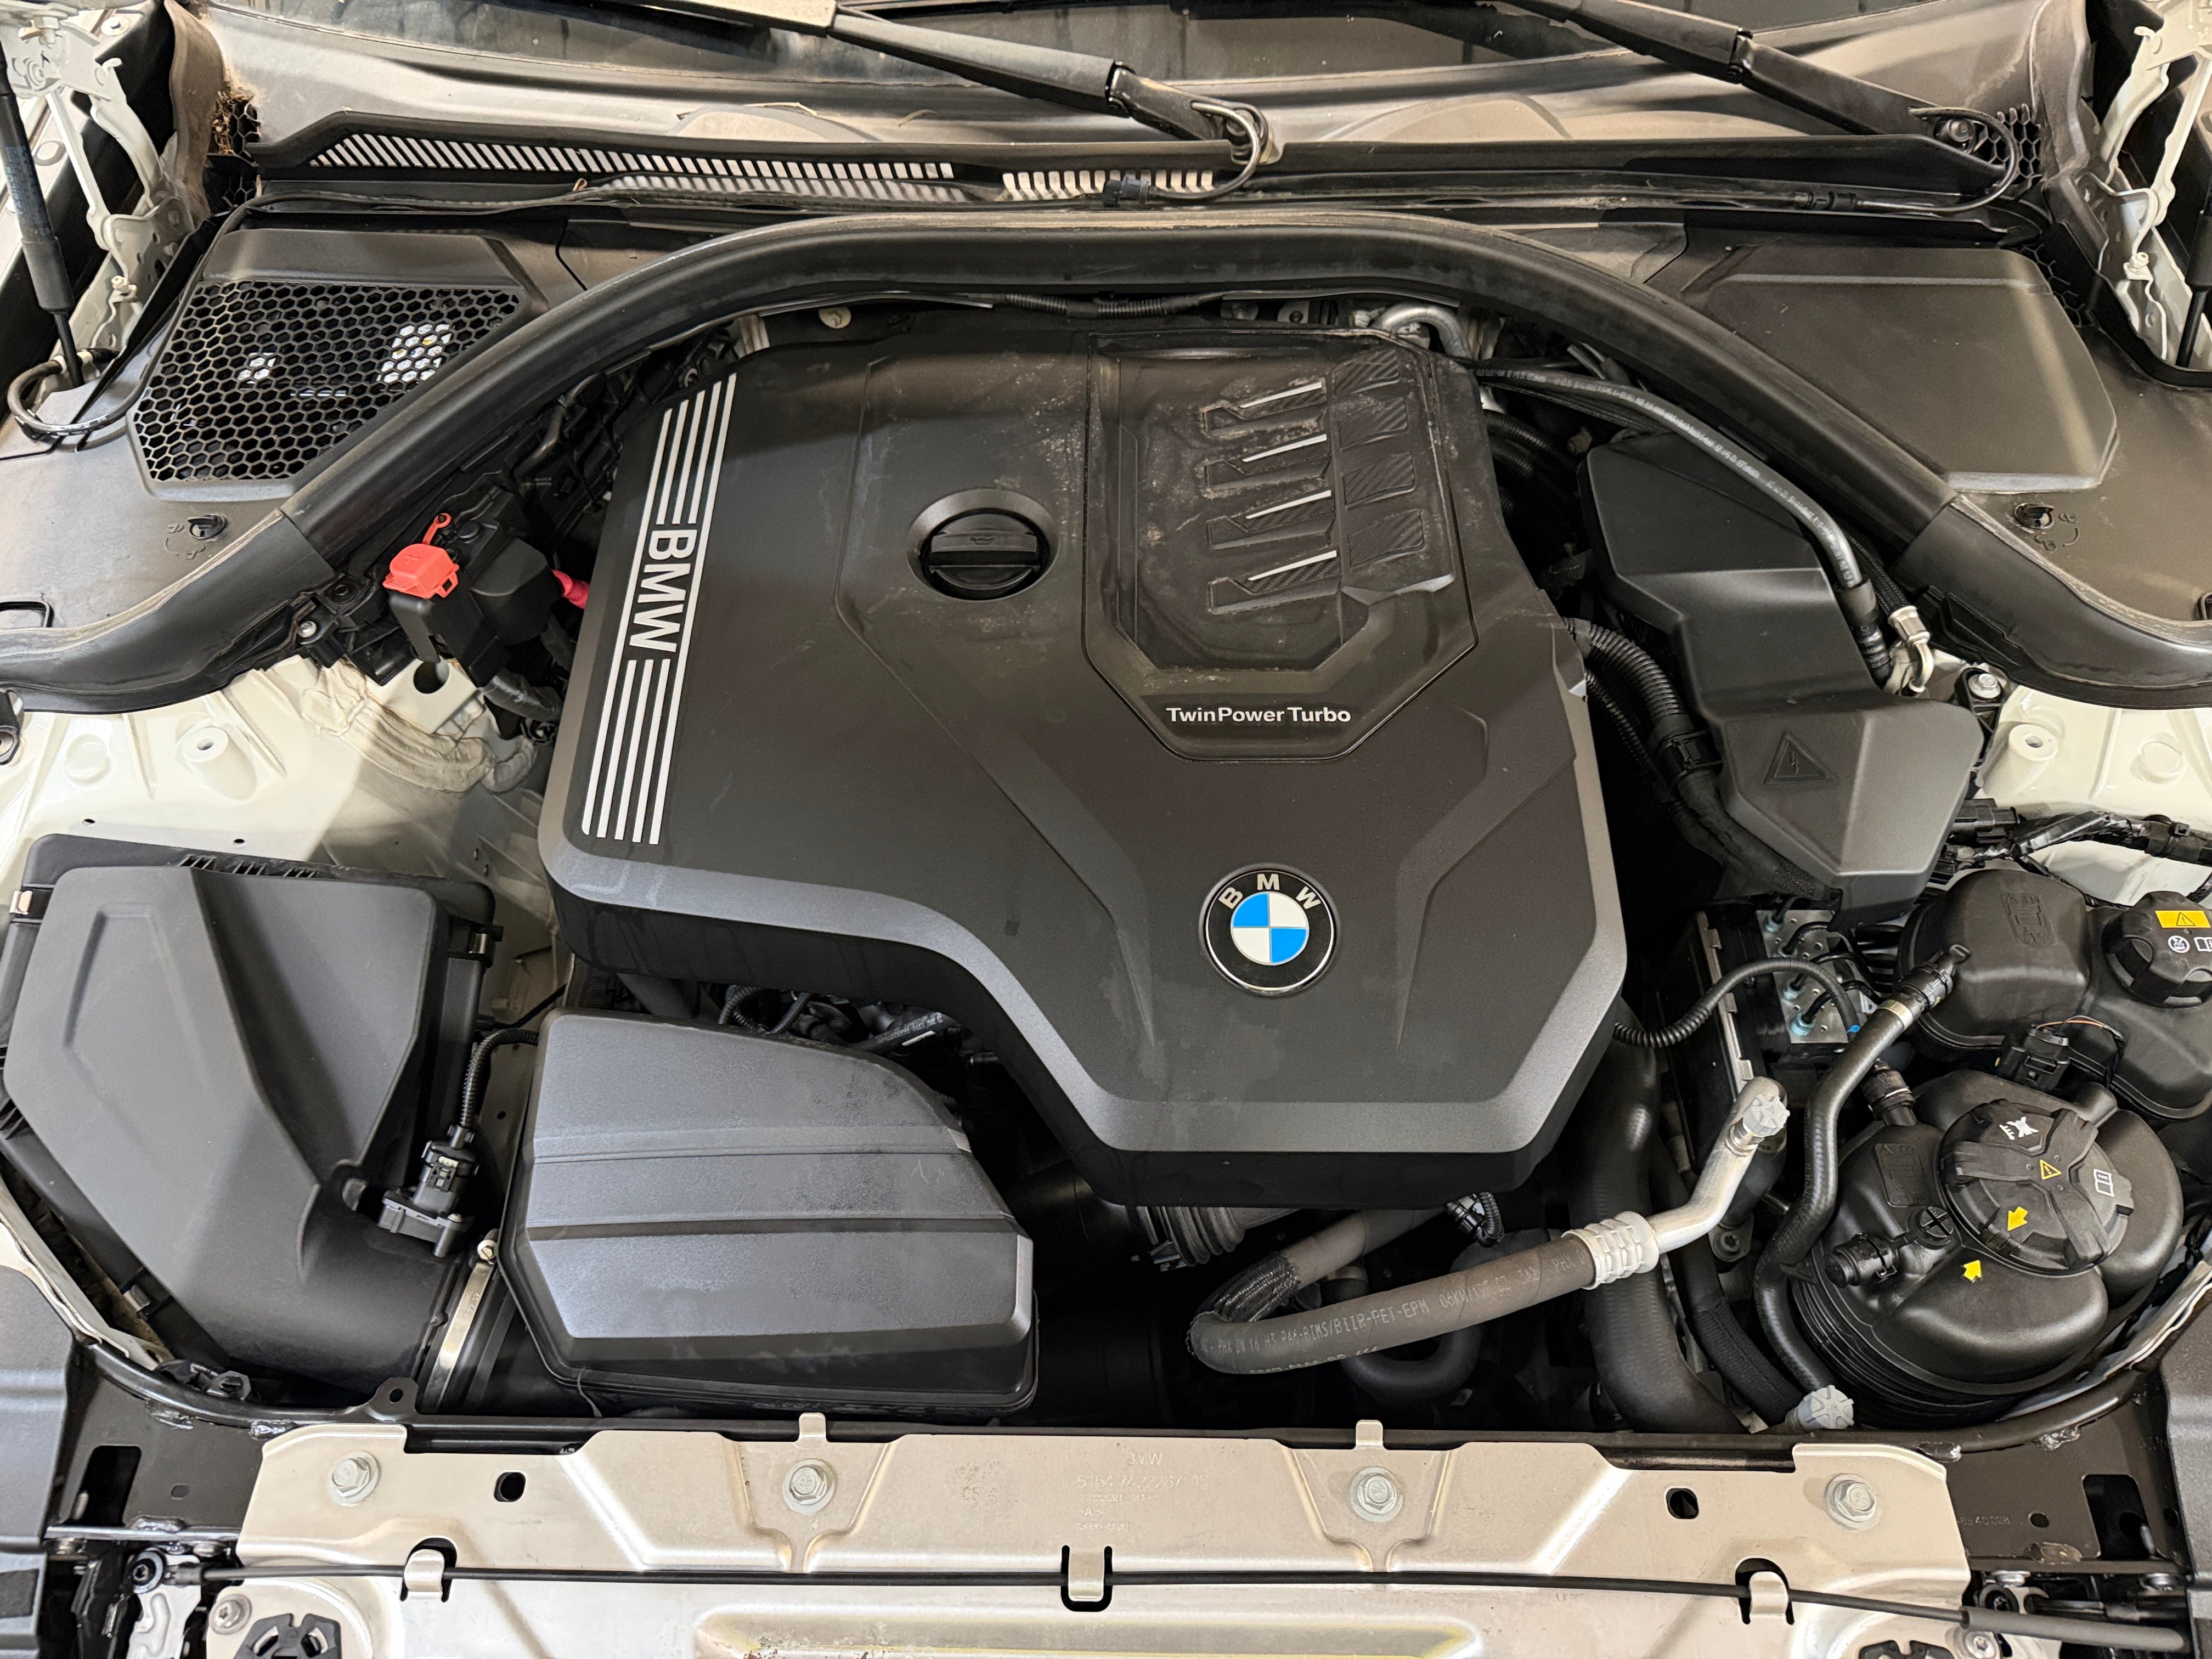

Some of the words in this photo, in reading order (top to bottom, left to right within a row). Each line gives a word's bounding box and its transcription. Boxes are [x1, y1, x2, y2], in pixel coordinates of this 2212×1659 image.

[629, 529, 694, 653] BMW
[1166, 707, 1285, 723] TwinPower
[1286, 706, 1352, 723] Turbo
[1218, 873, 1322, 911] BMW
[1125, 1452, 1163, 1466] BMW
